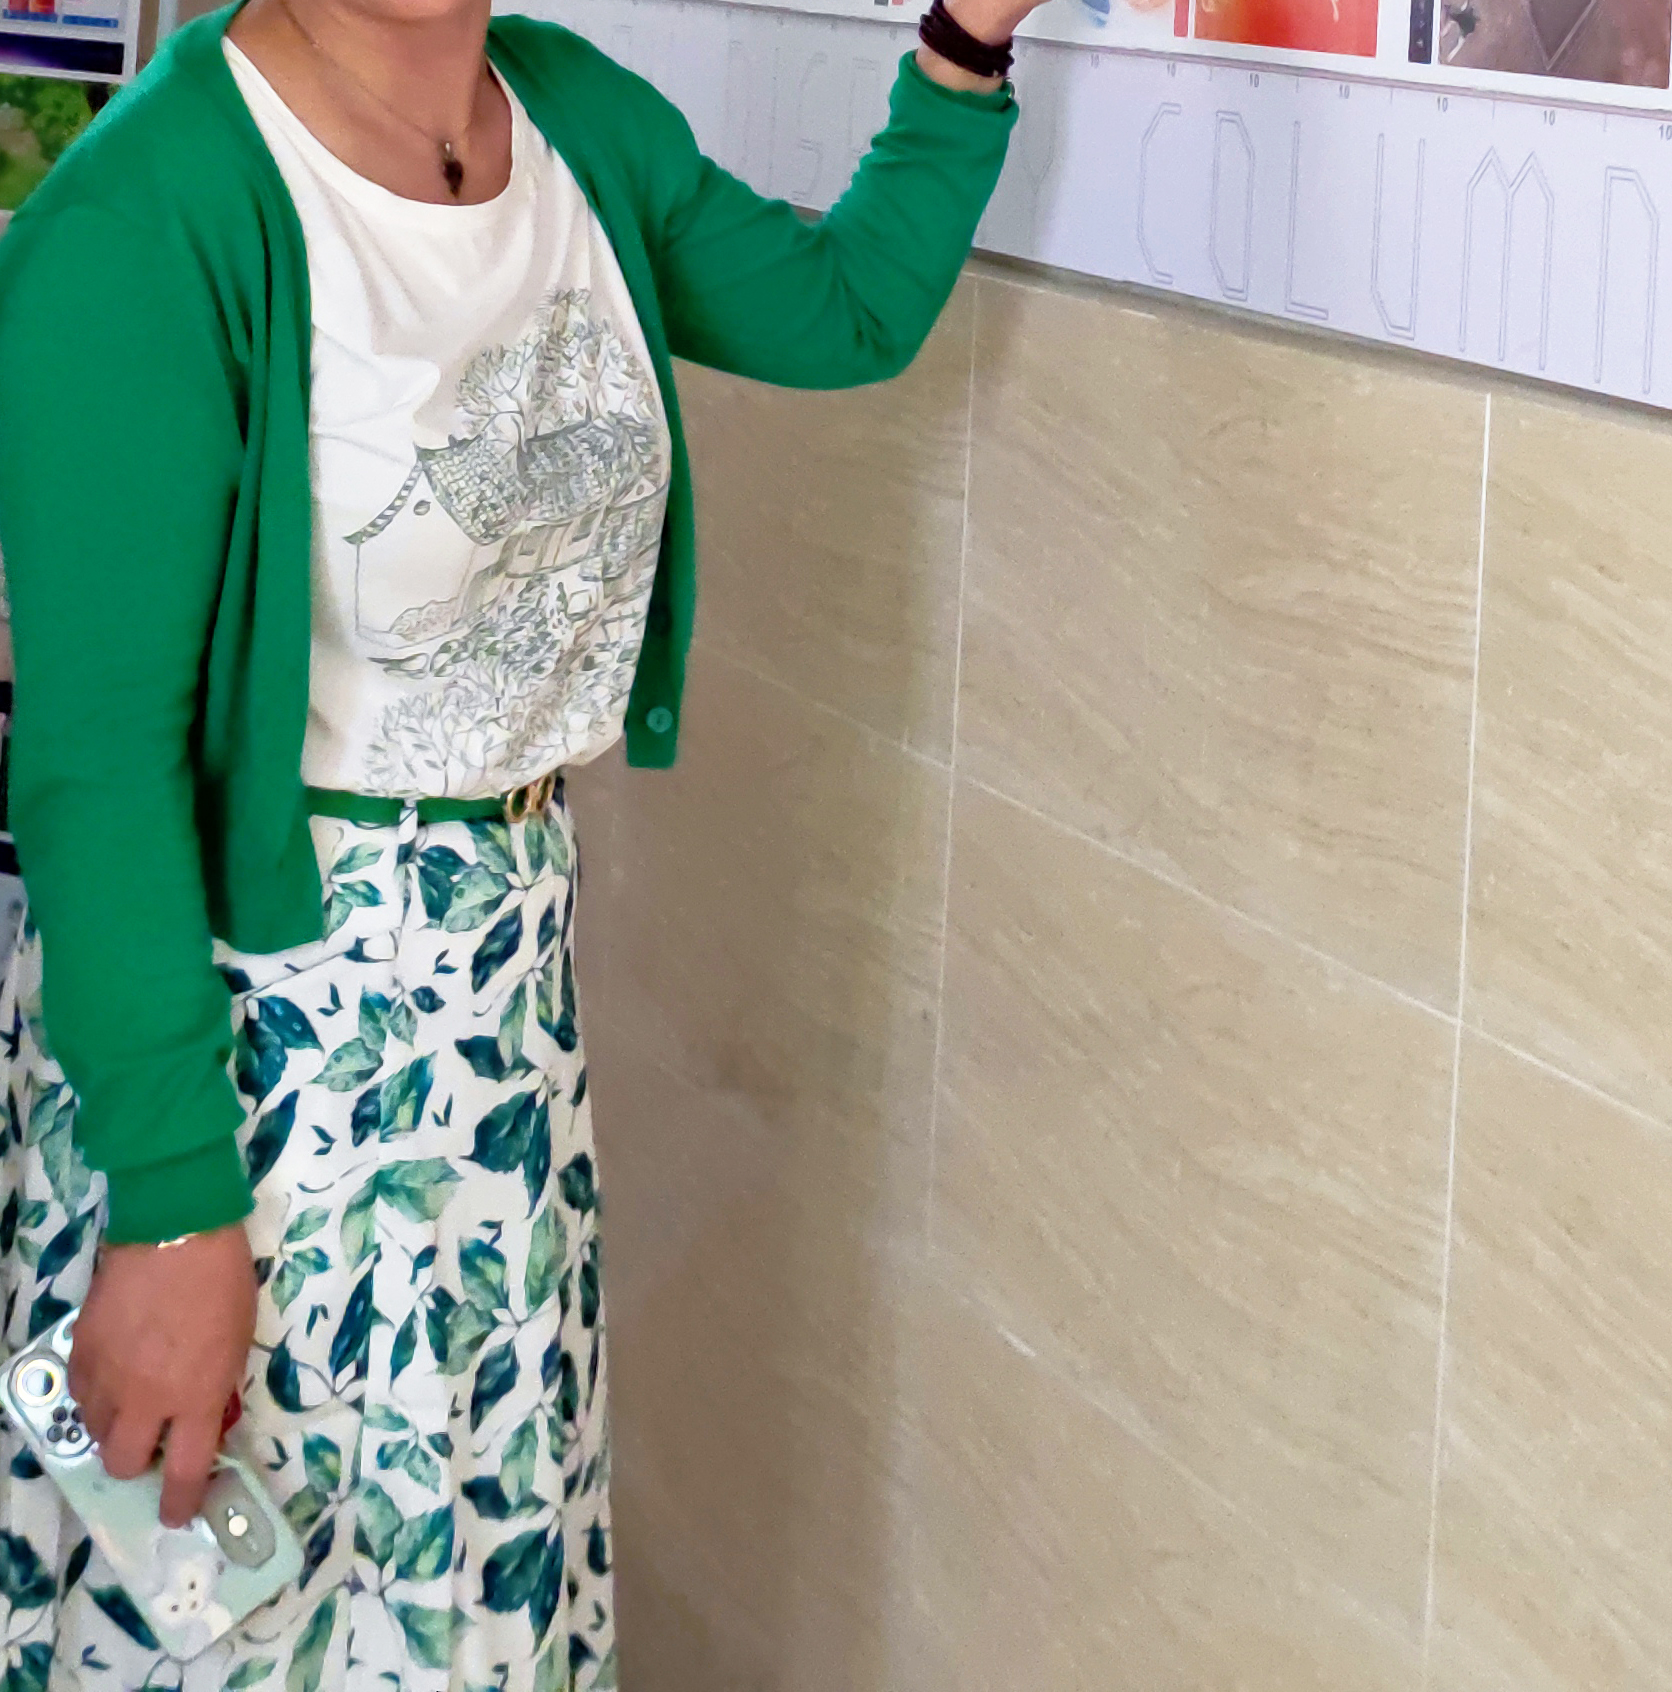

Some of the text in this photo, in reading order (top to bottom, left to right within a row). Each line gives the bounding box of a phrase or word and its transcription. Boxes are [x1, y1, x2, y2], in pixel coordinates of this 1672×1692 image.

[1249, 73, 1260, 88] 10
[1339, 85, 1350, 99] 10
[1437, 97, 1448, 112] 10
[1543, 110, 1555, 126] 10
[1659, 125, 1672, 140] 10
[1137, 102, 1660, 394] COLUMN
